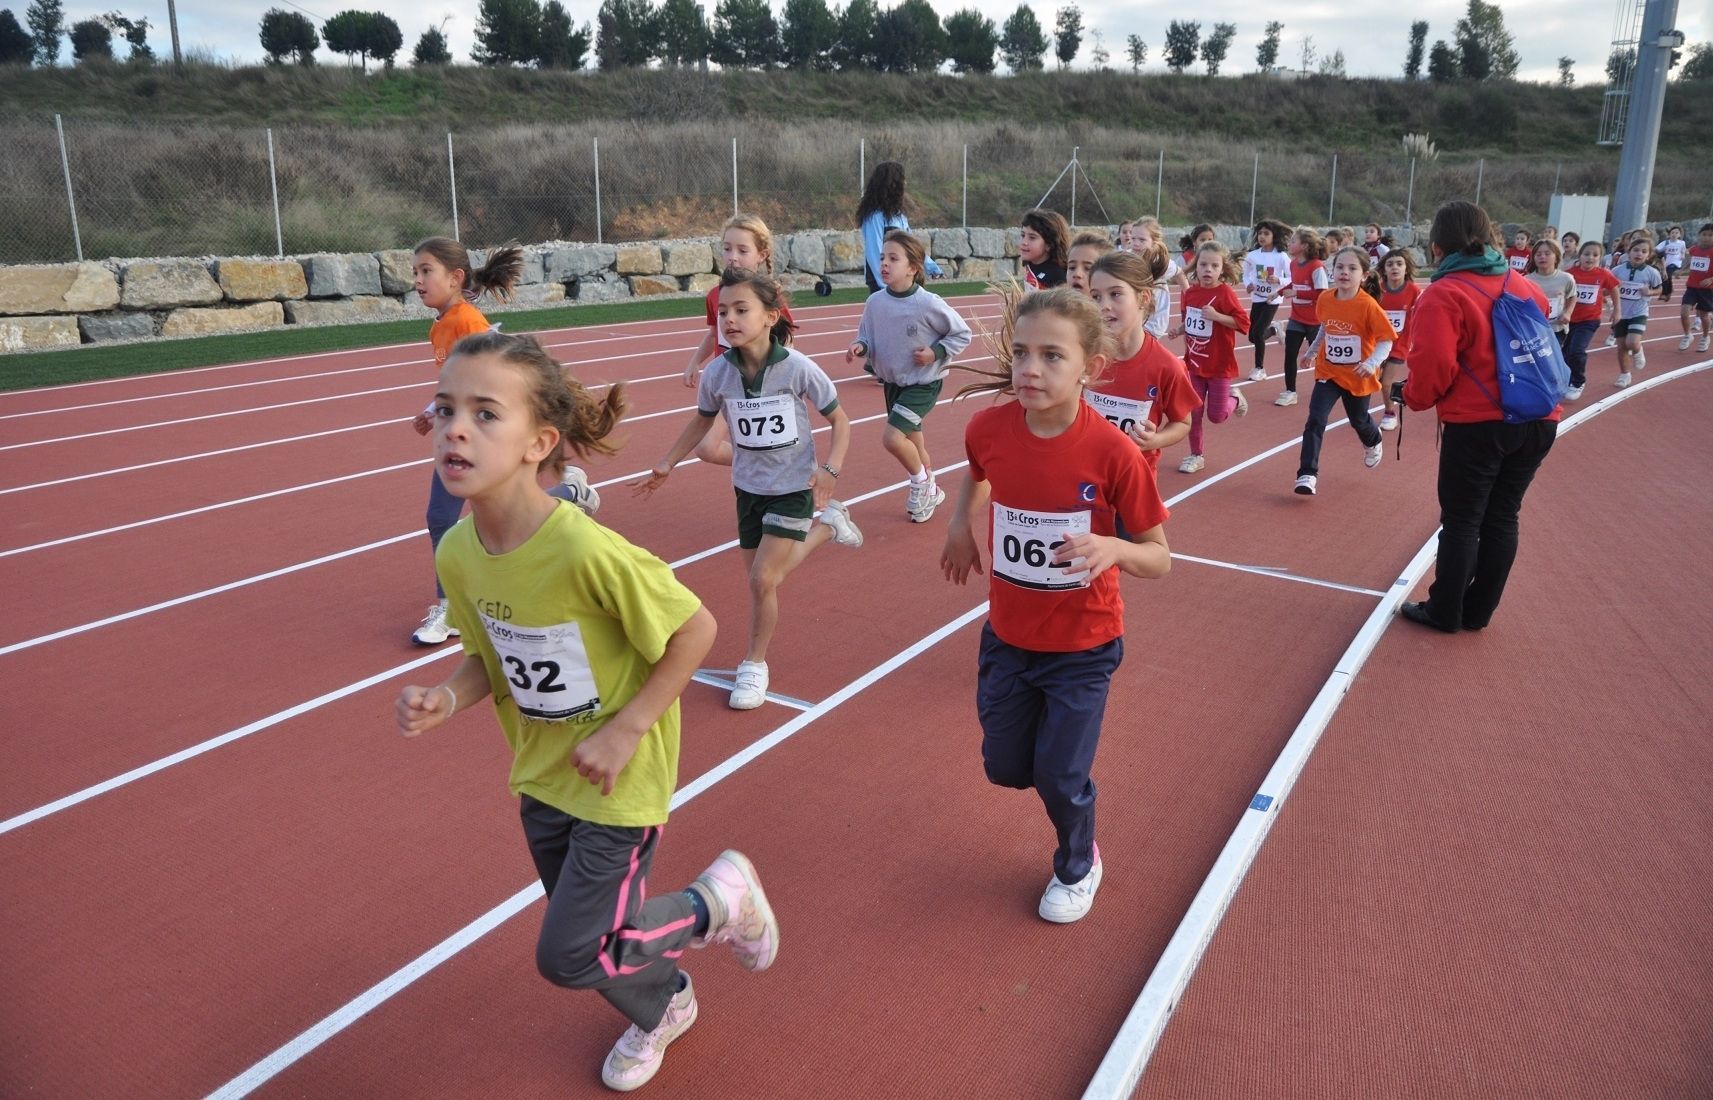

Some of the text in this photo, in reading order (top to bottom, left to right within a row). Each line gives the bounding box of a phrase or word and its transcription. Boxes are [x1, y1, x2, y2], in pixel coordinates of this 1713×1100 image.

[1256, 284, 1272, 294] 206
[1620, 287, 1639, 296] 097
[1186, 317, 1206, 331] 013
[1328, 345, 1354, 358] 299
[745, 400, 761, 409] Cros
[1102, 396, 1118, 407] Cros
[738, 414, 785, 437] 073
[1018, 512, 1039, 526] Cros
[493, 622, 513, 638] Cros
[496, 653, 567, 694] 32
